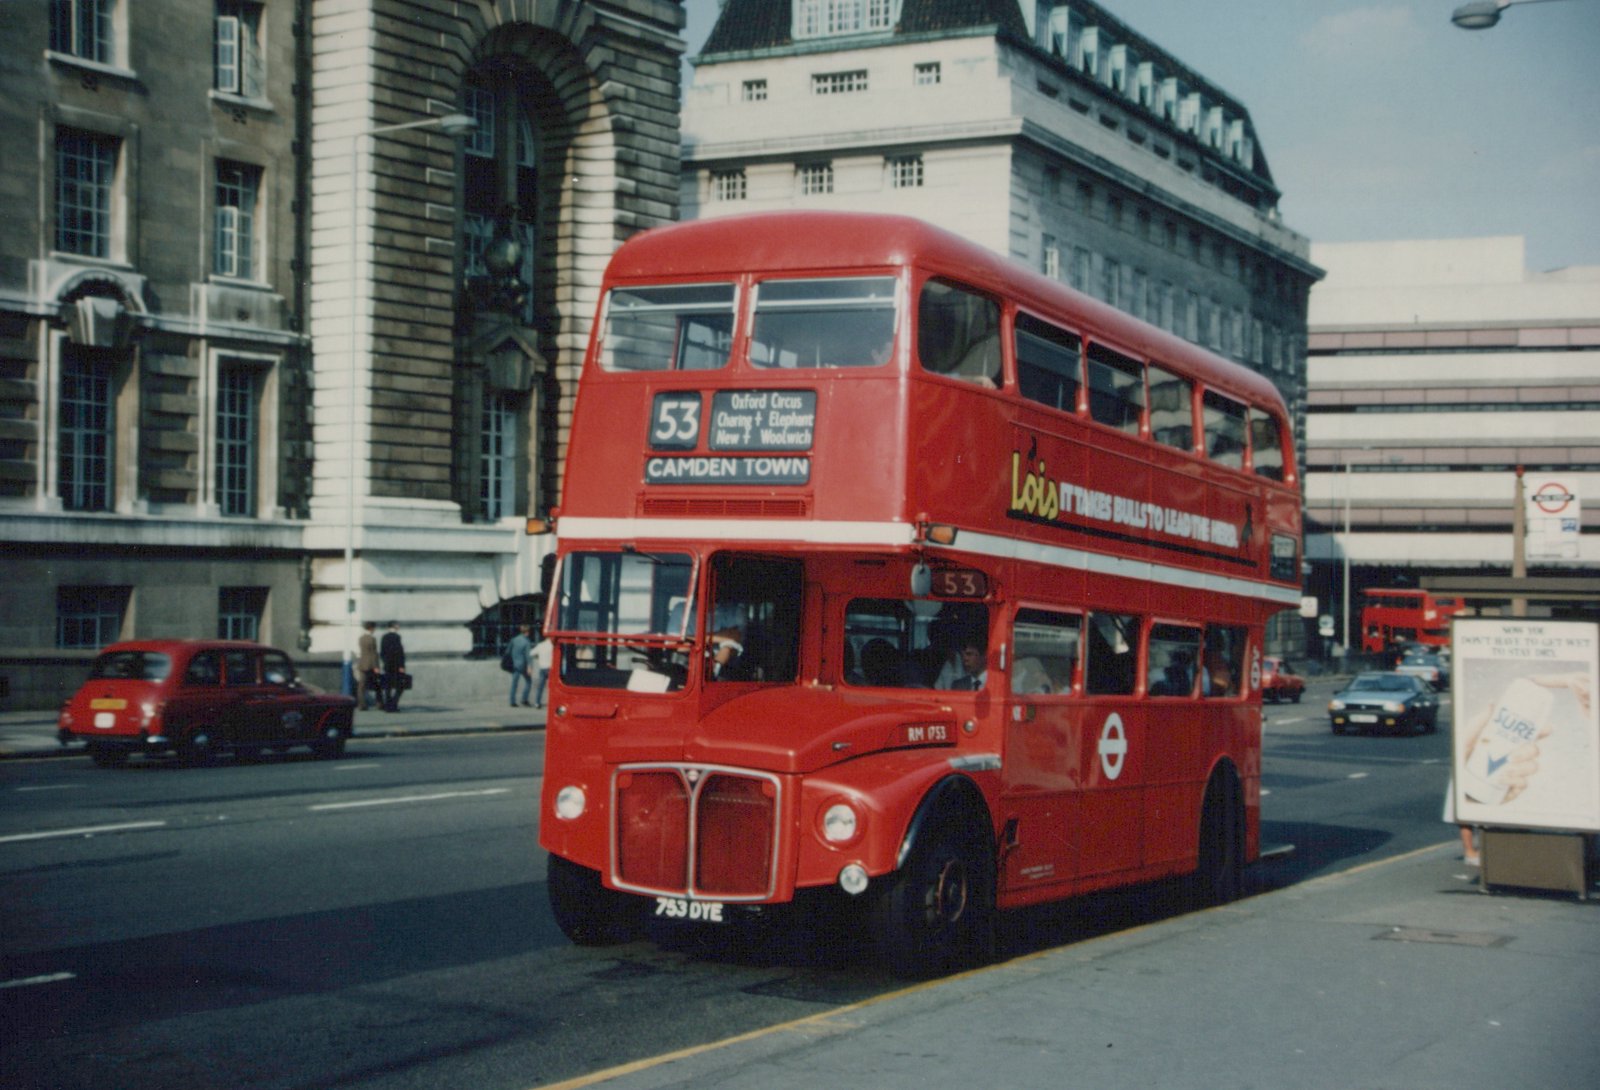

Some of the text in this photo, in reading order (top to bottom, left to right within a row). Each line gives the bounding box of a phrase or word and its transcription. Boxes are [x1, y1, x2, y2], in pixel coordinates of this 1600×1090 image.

[731, 392, 802, 409] Oxford Circus
[656, 401, 699, 440] 53
[717, 411, 752, 430] Charing
[768, 411, 814, 429] Elephant
[716, 429, 740, 444] New
[760, 429, 812, 444] Woolwich
[648, 457, 808, 477] CAMDEN TOWN
[1012, 451, 1059, 519] Lois
[1059, 481, 1074, 512] IT
[1074, 485, 1112, 522] TAKES
[1113, 495, 1147, 529] BULLS
[1146, 503, 1164, 531] TO
[945, 573, 976, 595] 53
[1525, 637, 1538, 647] TO
[1493, 706, 1536, 739] SURE
[908, 727, 924, 742] RM
[655, 897, 723, 921] 753 DYE
